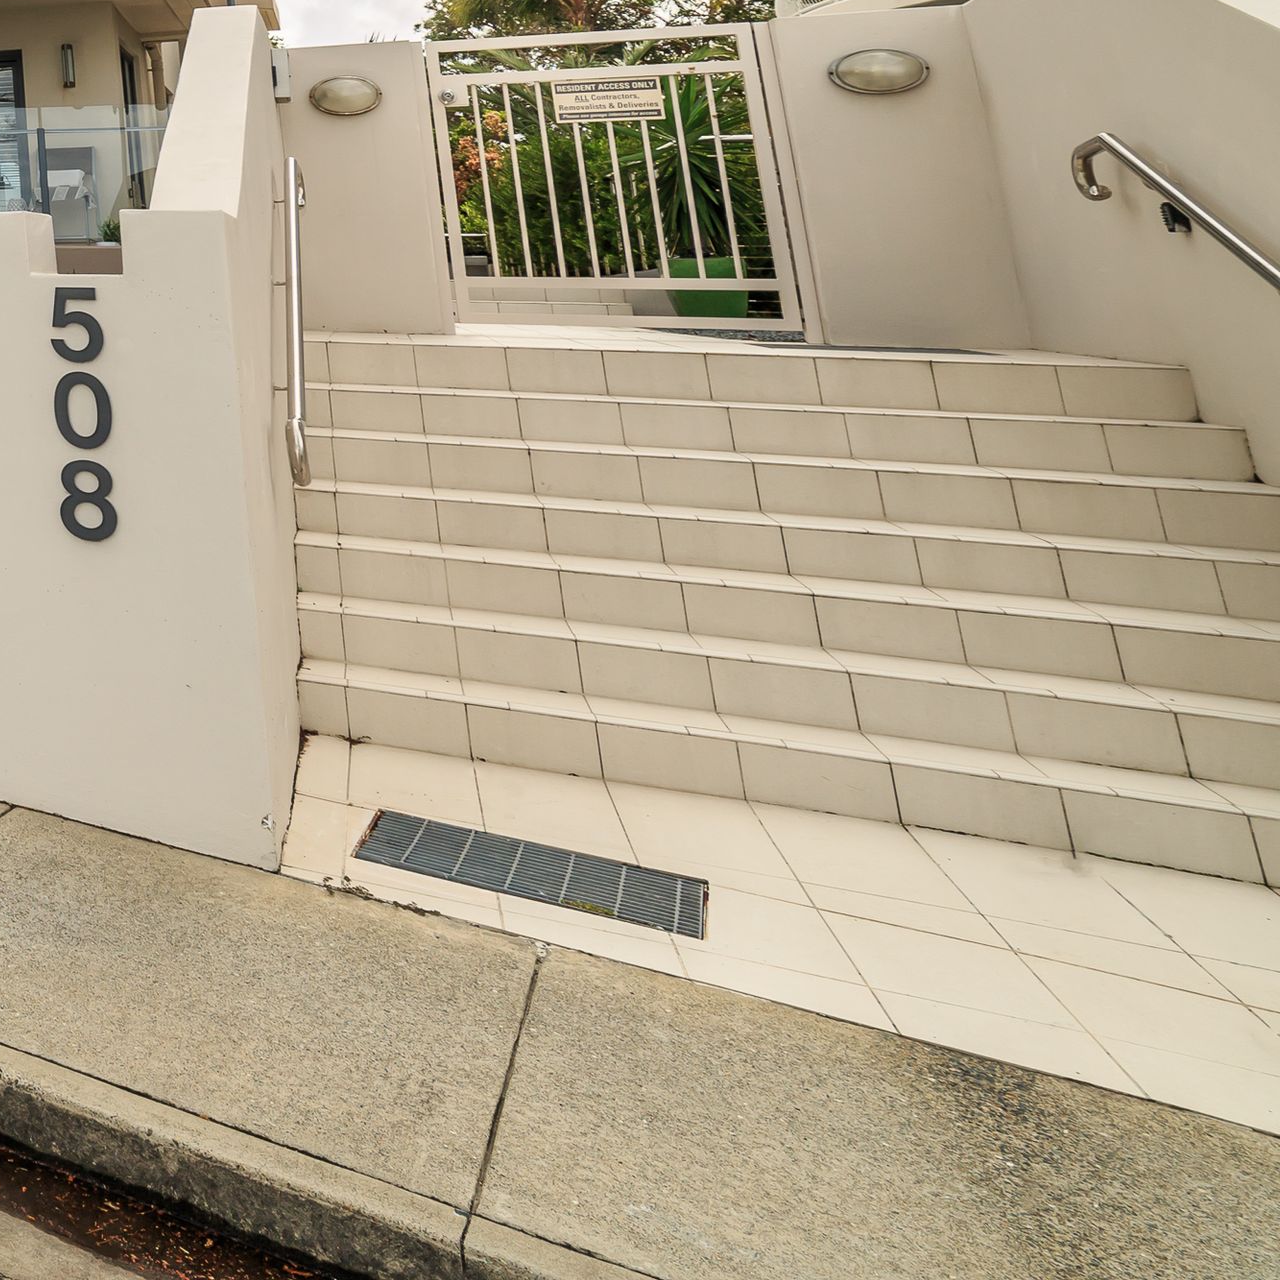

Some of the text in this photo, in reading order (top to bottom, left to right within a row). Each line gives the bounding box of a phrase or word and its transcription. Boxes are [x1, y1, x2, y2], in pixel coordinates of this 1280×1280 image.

[556, 81, 655, 93] RESIDENT ACCESS ONLY
[574, 95, 589, 103] ALL
[558, 103, 607, 111] Removalists
[617, 100, 659, 109] Deliveries
[50, 286, 118, 542] 508
